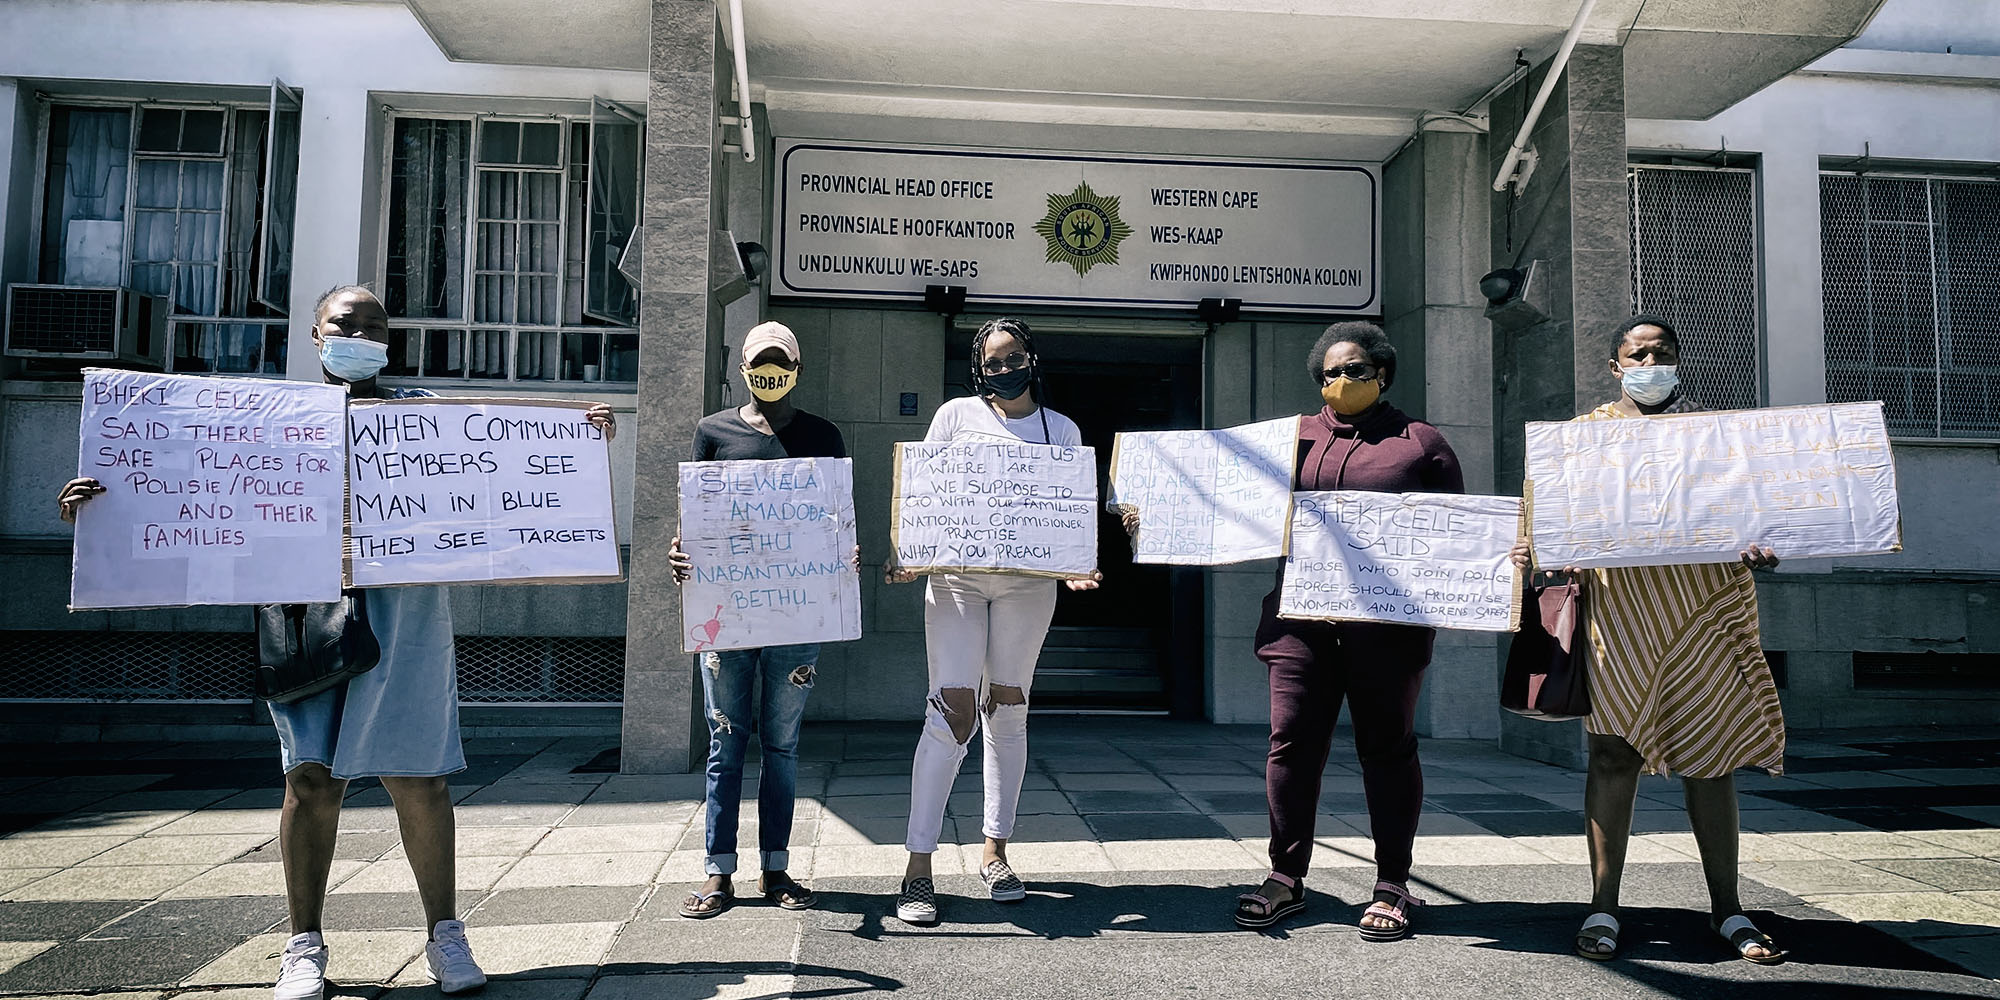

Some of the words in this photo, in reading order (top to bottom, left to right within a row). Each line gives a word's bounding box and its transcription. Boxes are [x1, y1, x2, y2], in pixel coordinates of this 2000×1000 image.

[800, 173, 891, 195] PROVINCIAL
[895, 178, 936, 197] HEAD
[940, 180, 994, 200] OFFICE
[1151, 188, 1218, 208] WESTERN
[1222, 191, 1259, 209] CAPE
[799, 213, 899, 235] PROVINSIALE
[903, 218, 1015, 240] HOOFKANTOOR
[1057, 205, 1078, 225] SOUTH
[1081, 204, 1109, 227] AFRICAN
[1058, 237, 1079, 255] POLICE
[1081, 238, 1108, 255] SERVICE
[1151, 225, 1224, 245] WES-KAAP
[798, 254, 905, 276] UNDLUNKULU
[911, 258, 979, 278] WE-SAPS
[1150, 263, 1229, 283] KWIPHONDO
[1233, 266, 1311, 286] LENTSHONA
[1314, 268, 1363, 287] KOLONI
[90, 381, 170, 406] BHEKI
[183, 424, 265, 444] THERE
[283, 426, 326, 443] ARE
[350, 413, 440, 447] WHEN
[464, 413, 603, 442] COMMUNITY
[95, 446, 154, 468] SAFE
[195, 447, 283, 472] PLACES
[904, 446, 974, 459] MINISTER
[986, 444, 1041, 459] TELL
[1050, 447, 1074, 462] US
[355, 451, 498, 481] MEMBERS
[524, 455, 577, 475] SEE
[928, 461, 986, 475] WHERE
[1007, 462, 1035, 474] ARE
[1120, 474, 1157, 488] YOU
[1165, 474, 1206, 488] ARE
[1216, 459, 1289, 487] SENDING
[700, 471, 818, 493] SILWELA
[931, 480, 957, 494] WE
[968, 480, 1039, 496] SUPPOSE
[1048, 485, 1073, 499] TO
[355, 493, 427, 523] MAN
[502, 491, 562, 511] BLUE
[905, 496, 932, 508] GO
[987, 496, 1014, 509] OUR
[1192, 493, 1225, 507] TO
[1231, 488, 1262, 501] THE
[179, 503, 233, 520] AND
[901, 514, 980, 529] NATIONAL
[989, 512, 1085, 529] COMMISIONER
[1234, 507, 1282, 523] WHICH
[1299, 499, 1383, 527] BHEKI
[1391, 507, 1466, 533] CELE
[351, 534, 415, 558] THEY
[434, 531, 488, 550] SEE
[509, 527, 606, 545] TARGETS
[729, 531, 792, 555] ETHU
[1164, 529, 1196, 540] ARE
[1348, 530, 1430, 557] SAID
[898, 545, 938, 560] WHAT
[949, 544, 987, 558] YOU
[993, 544, 1051, 559] PREACH
[696, 560, 849, 584] NABANTWANA
[1298, 557, 1344, 572] THOSE
[1358, 564, 1399, 577] WHO
[1462, 570, 1512, 584] POLICE
[1293, 578, 1340, 593] FORCE
[1347, 583, 1412, 598] SHOULD
[1425, 588, 1503, 603] PRIORITISE
[1367, 603, 1396, 615] AND
[1475, 605, 1509, 621] SAFETY
